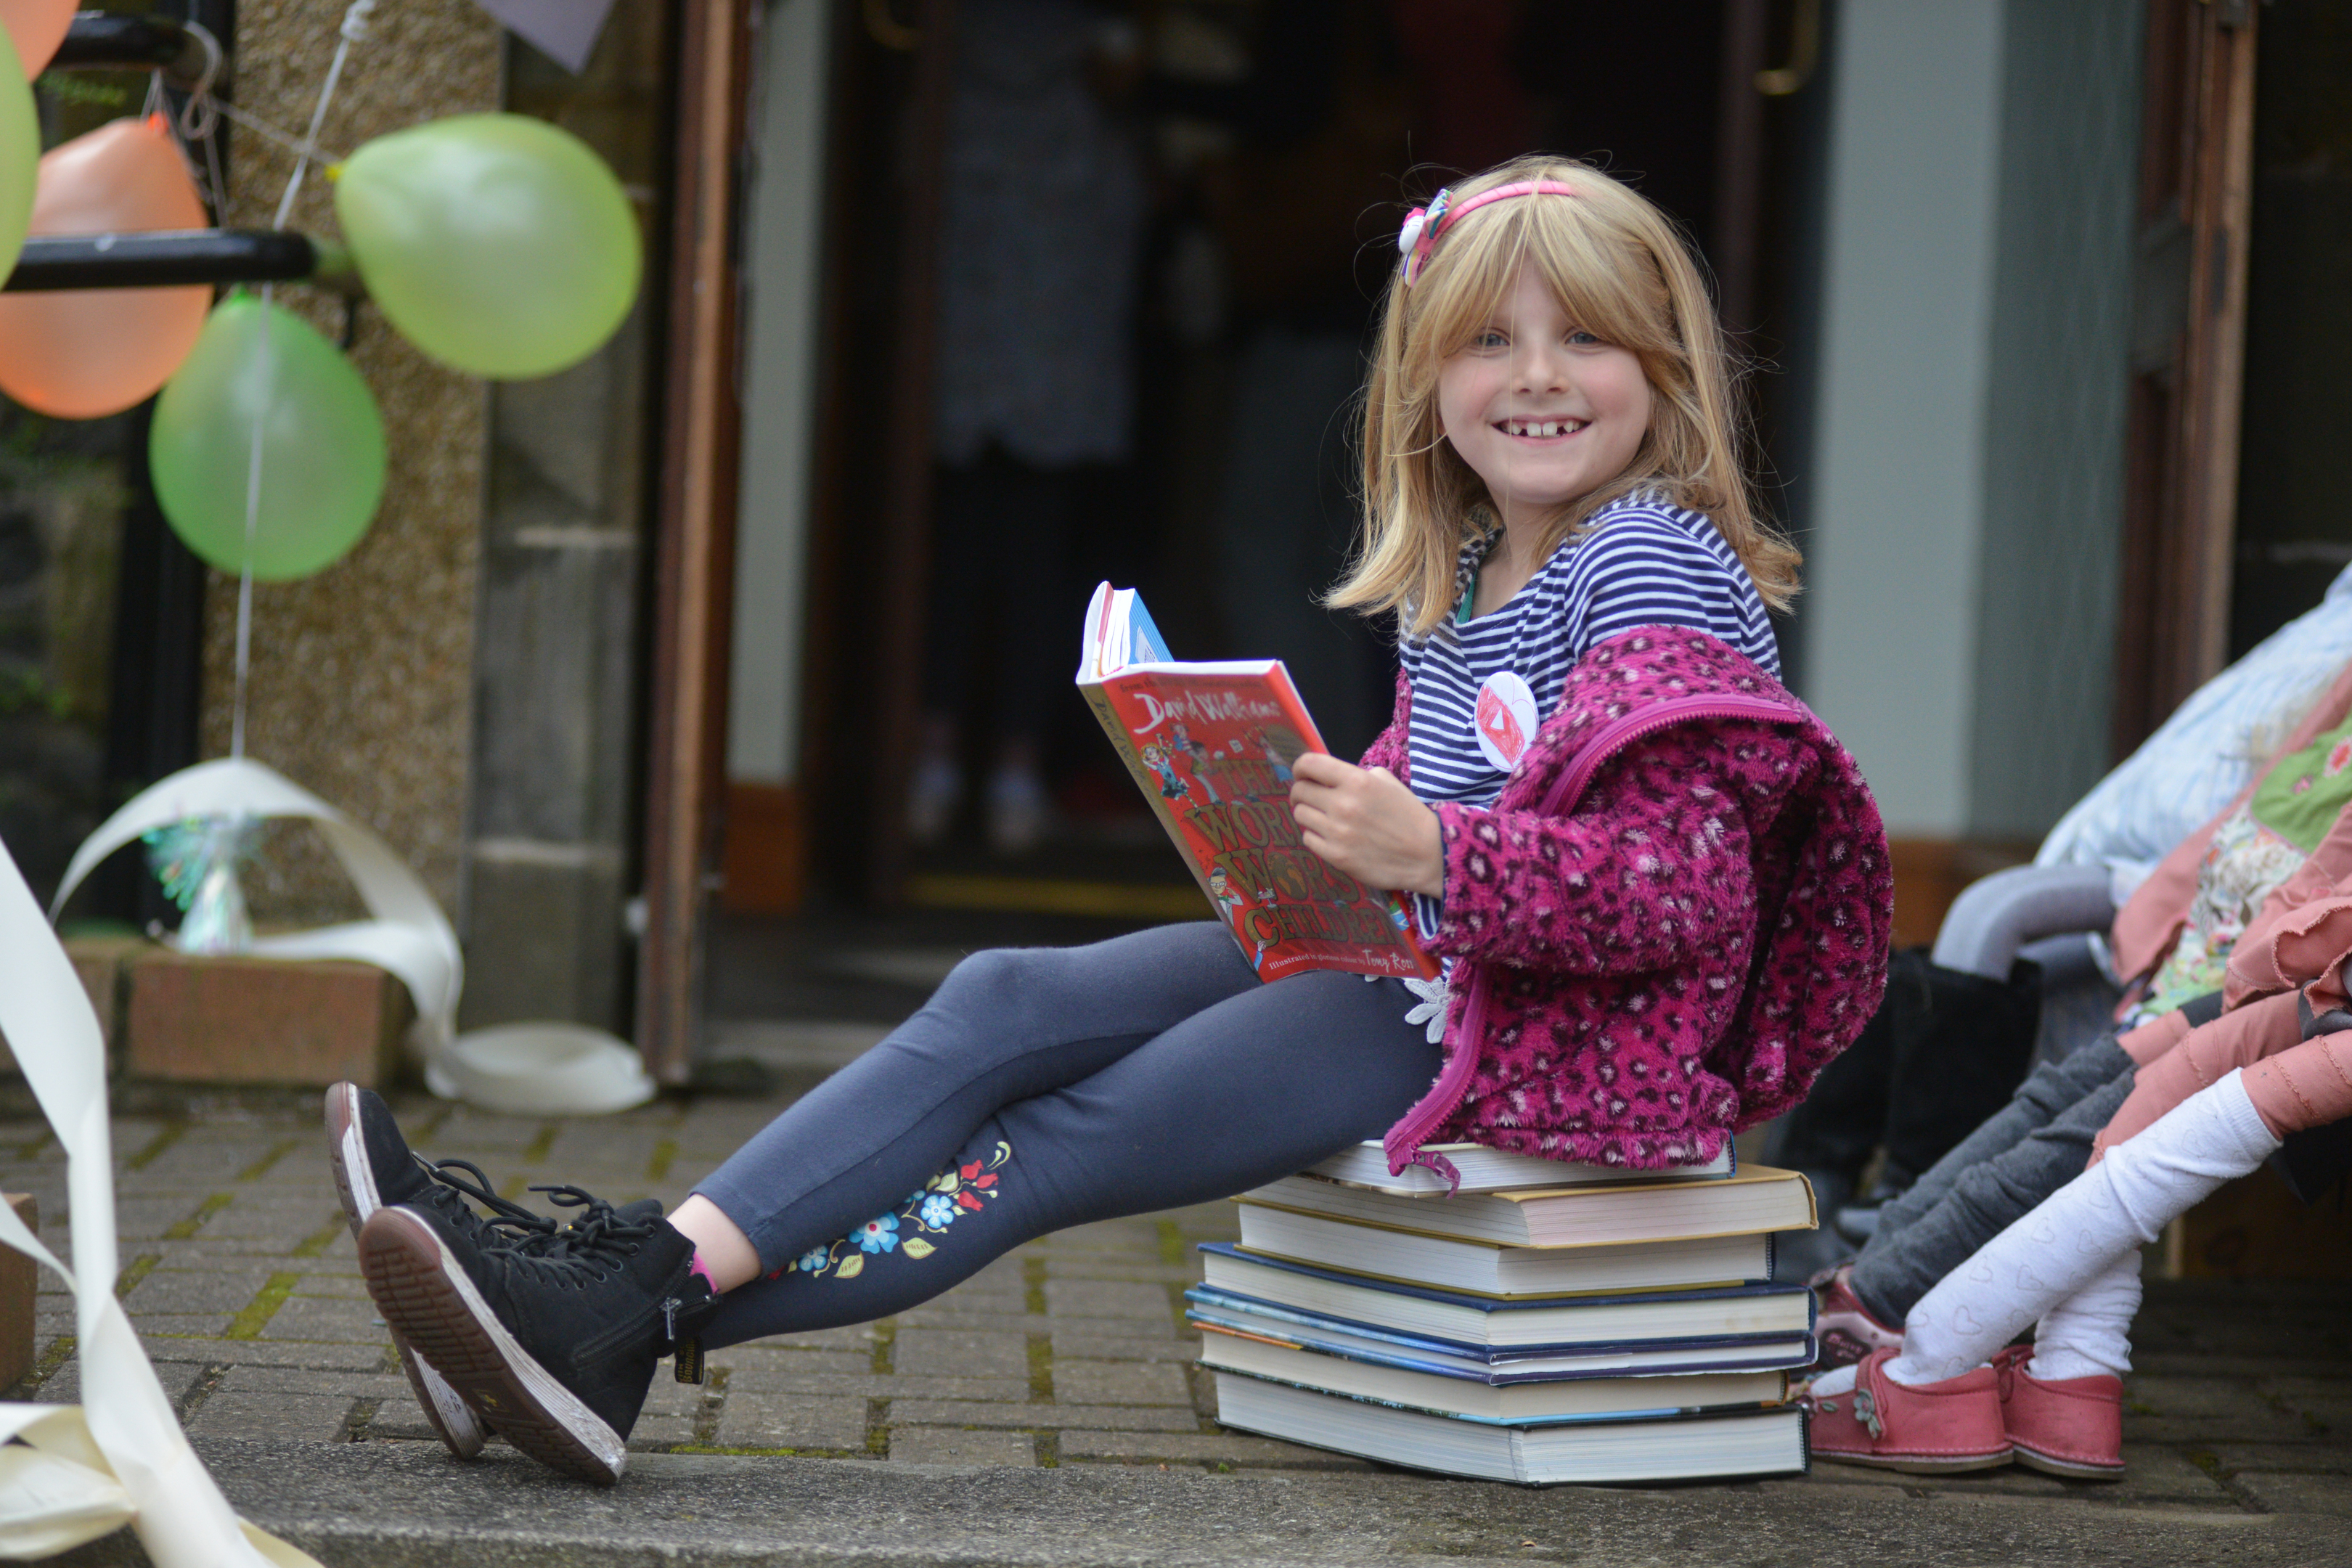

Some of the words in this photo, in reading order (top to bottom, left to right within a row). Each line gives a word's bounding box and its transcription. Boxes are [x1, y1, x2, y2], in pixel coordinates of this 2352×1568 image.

[1133, 690, 1207, 734] David
[1213, 759, 1291, 795] THE
[1213, 848, 1374, 904] WORS
[1244, 904, 1405, 947] CHILDREN
[1268, 953, 1310, 971] Illustrated
[1362, 949, 1390, 973] Tony
[1389, 952, 1414, 971] Ross
